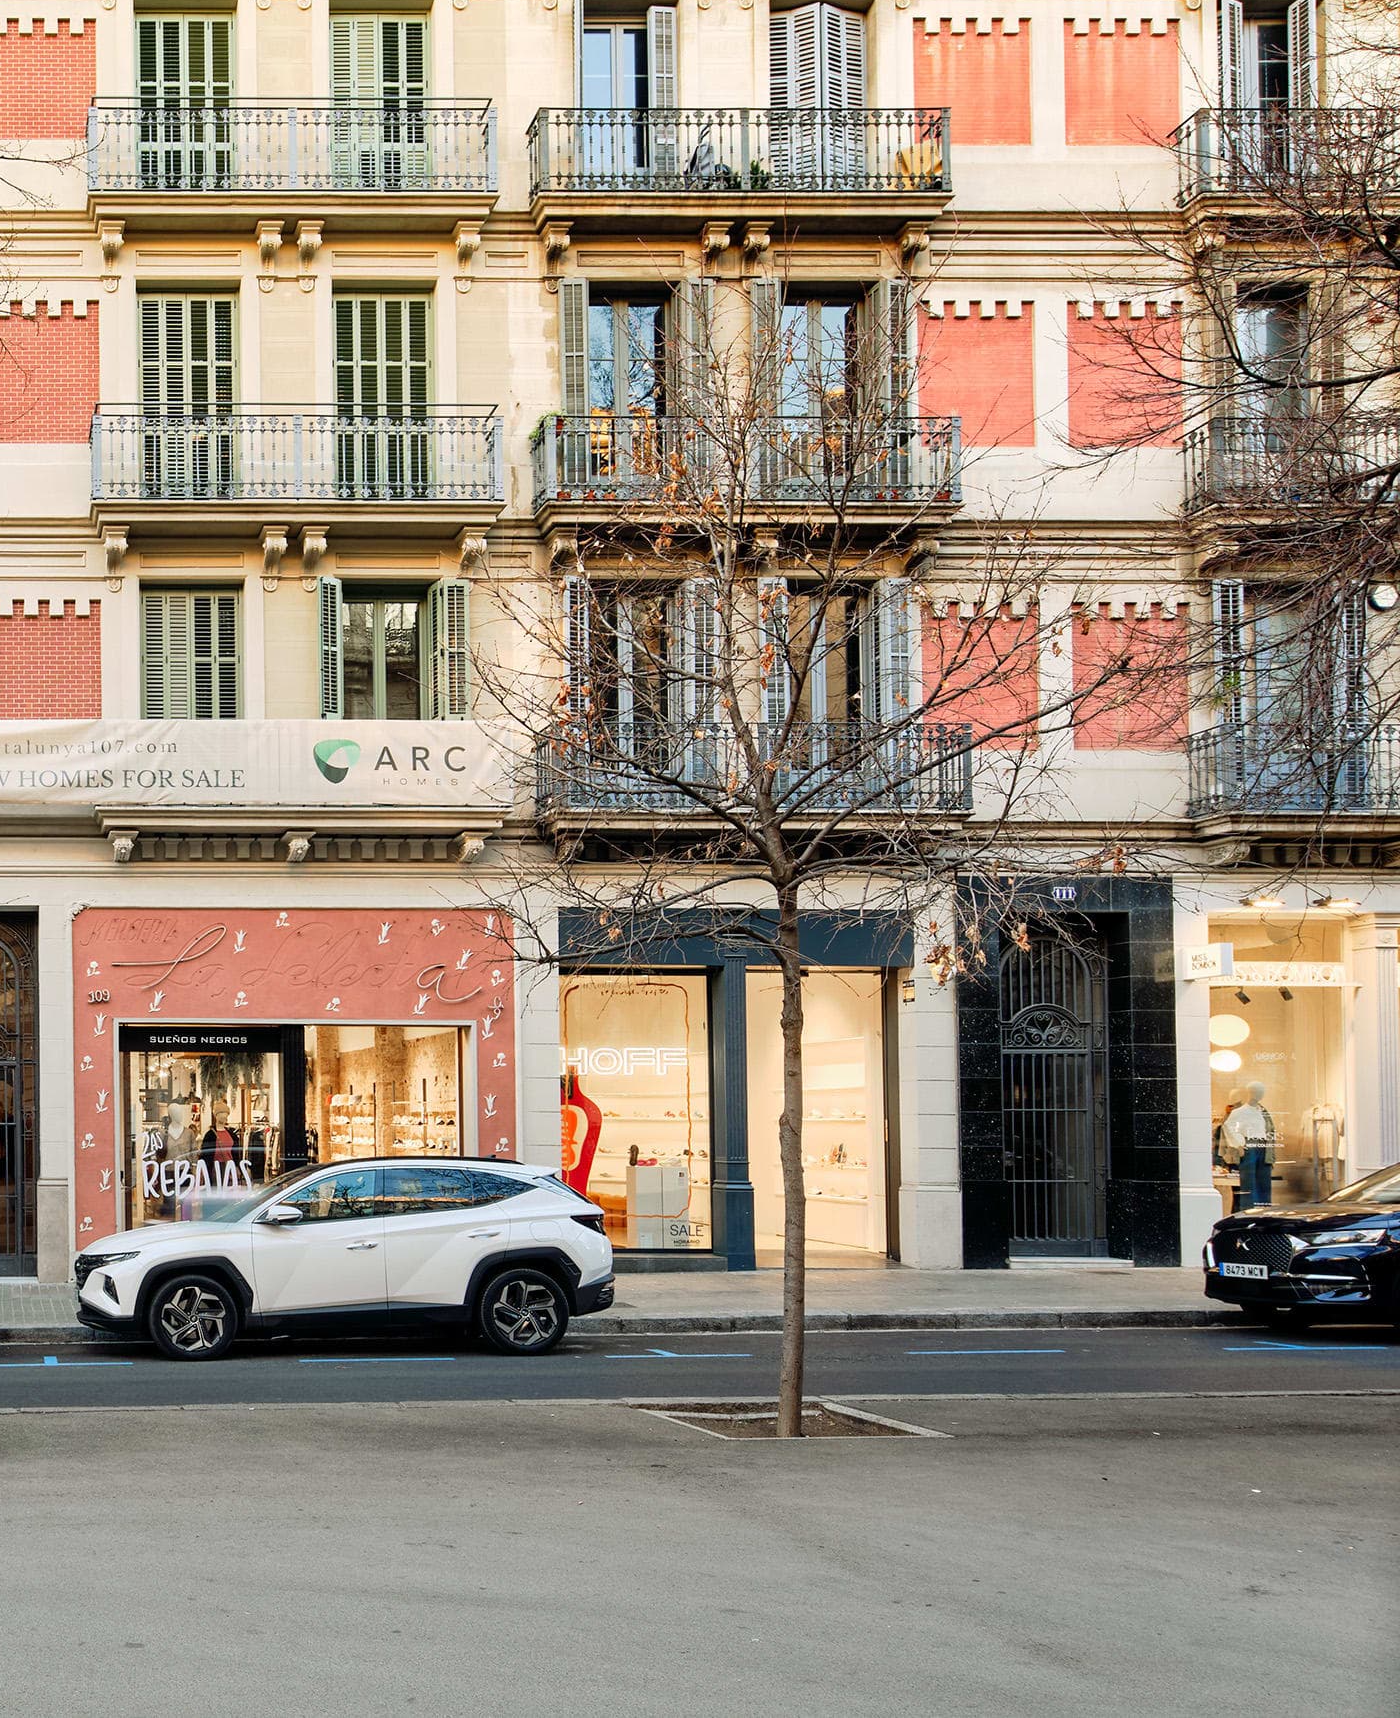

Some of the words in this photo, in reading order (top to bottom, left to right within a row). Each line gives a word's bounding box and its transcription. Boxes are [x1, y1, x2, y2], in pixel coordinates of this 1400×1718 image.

[374, 746, 467, 771] ARC
[19, 769, 114, 788] HOMES
[122, 769, 176, 788] FOR
[182, 769, 246, 788] SALE
[383, 778, 459, 786] HOMES
[1056, 888, 1073, 899] 111
[87, 988, 111, 1004] 109
[150, 1034, 197, 1044] SUEÑOS
[200, 1036, 248, 1044] NEGROS
[560, 1047, 688, 1075] HOFF
[669, 1224, 705, 1237] SALE
[1225, 1265, 1246, 1276] 8473
